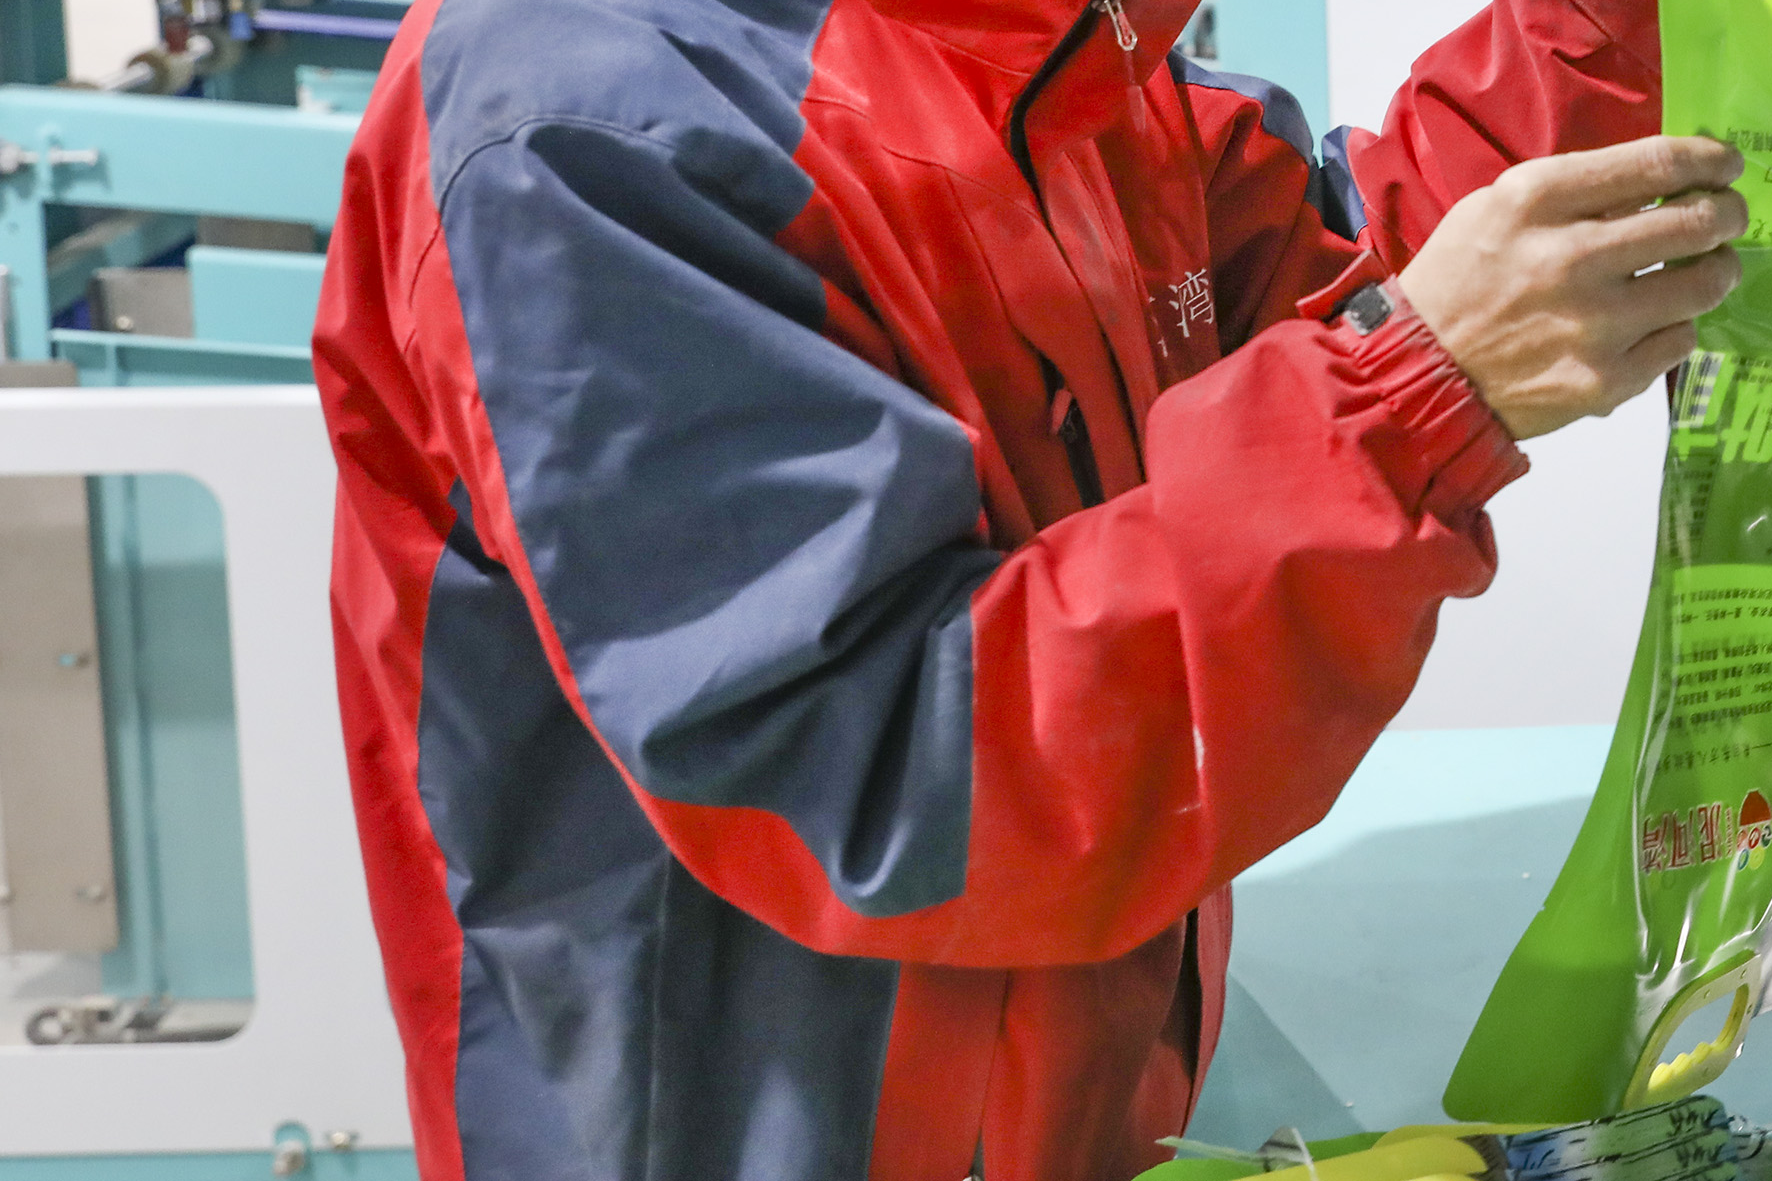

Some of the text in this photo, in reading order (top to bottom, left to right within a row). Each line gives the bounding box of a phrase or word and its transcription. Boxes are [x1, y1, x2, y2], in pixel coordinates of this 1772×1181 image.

[1148, 267, 1214, 358] 湾
[1641, 801, 1723, 876] 泥河湾
